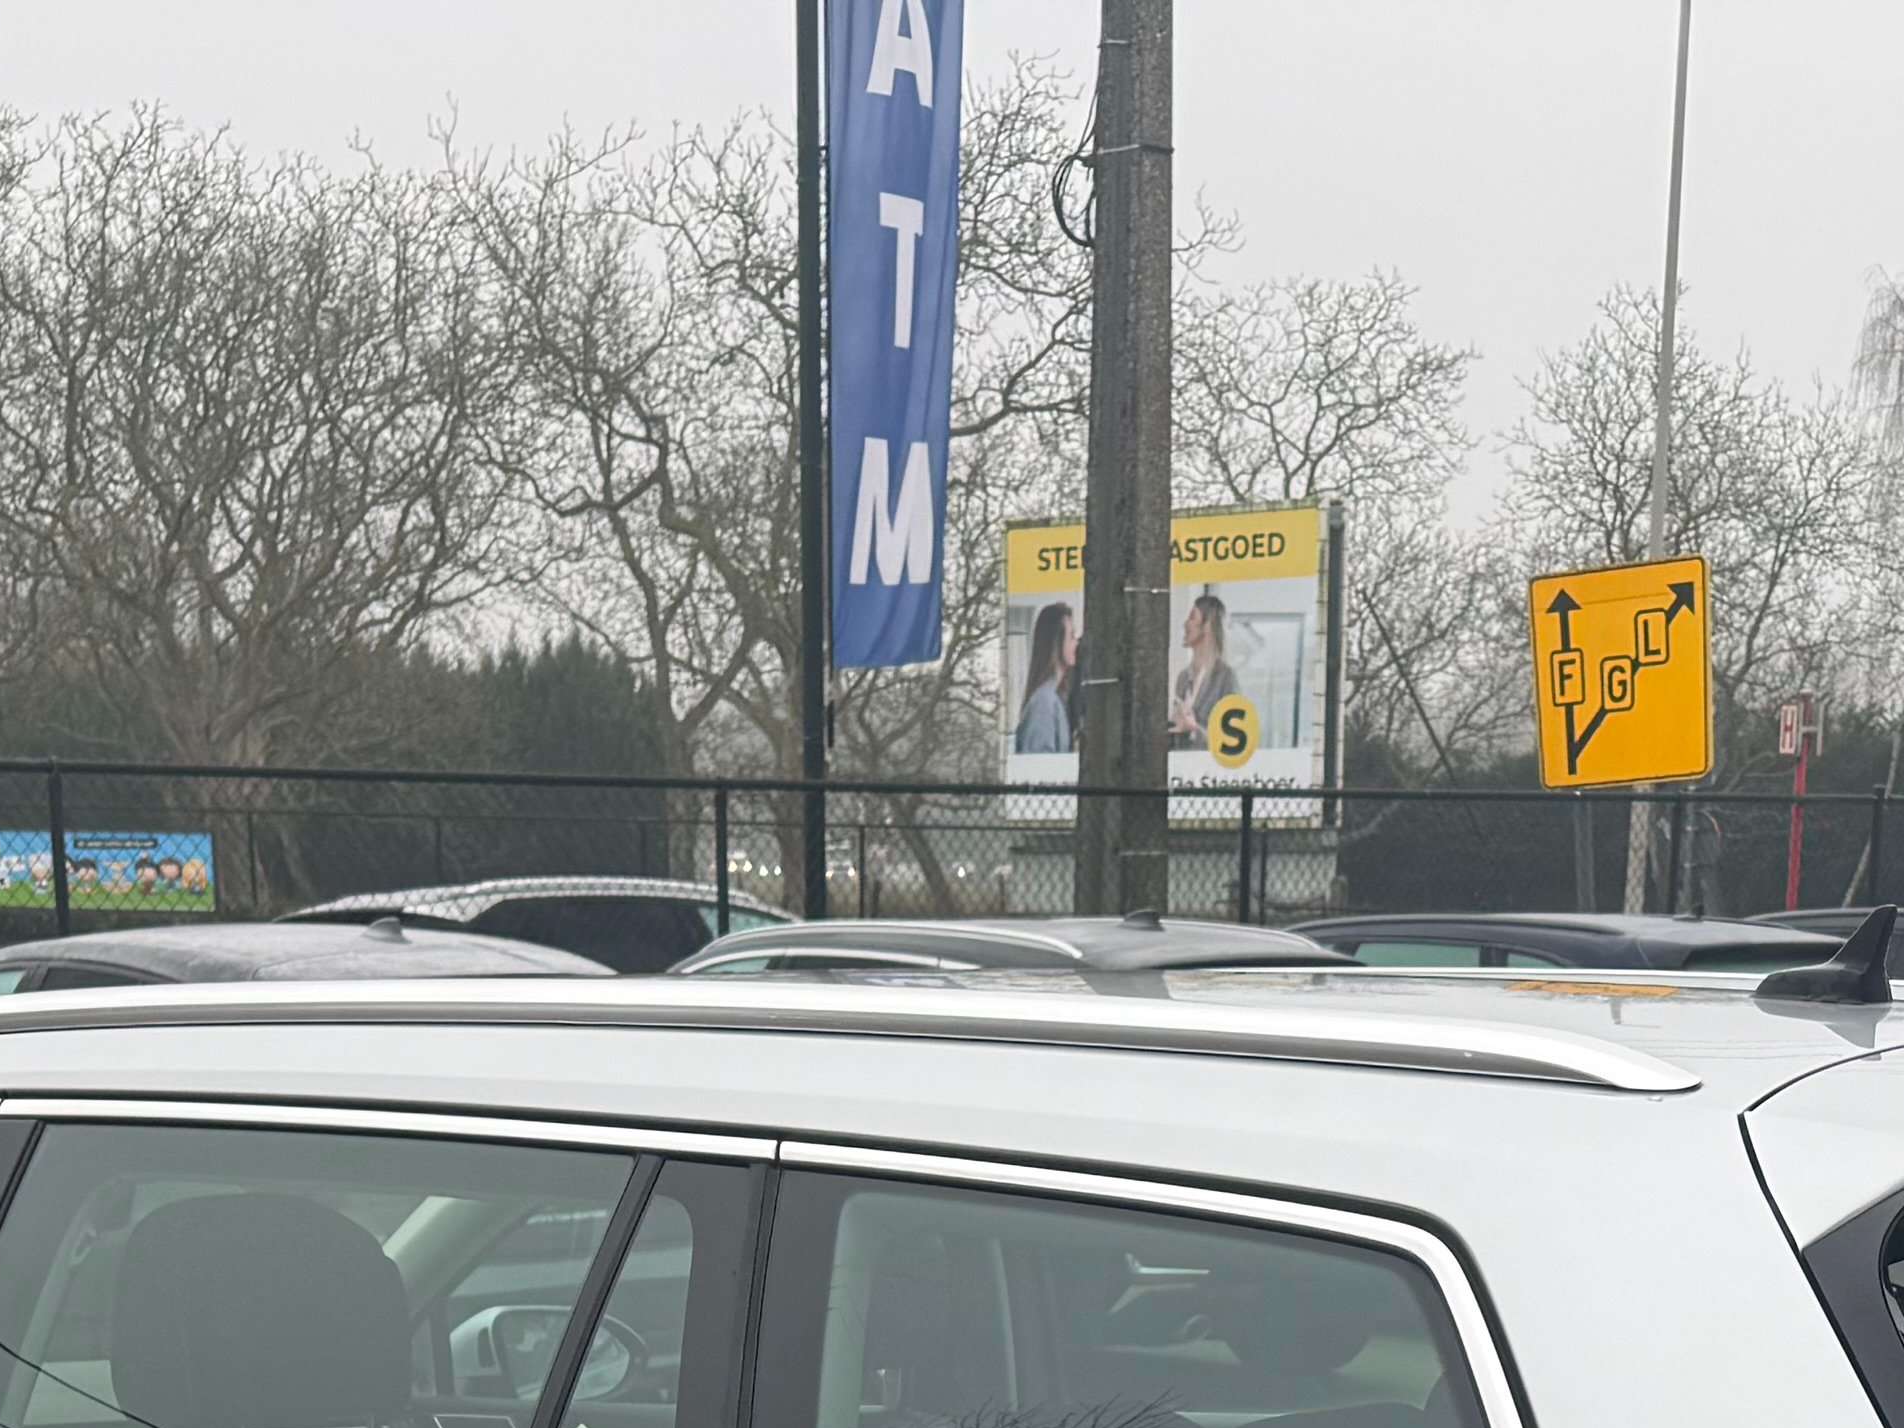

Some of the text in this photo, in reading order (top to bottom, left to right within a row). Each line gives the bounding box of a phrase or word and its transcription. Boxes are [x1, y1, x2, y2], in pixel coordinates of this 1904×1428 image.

[1037, 532, 1286, 571] STE ASTGOED
[1643, 619, 1662, 657] L
[1558, 658, 1576, 697] F
[1607, 665, 1628, 703] G
[1219, 708, 1248, 757] S
